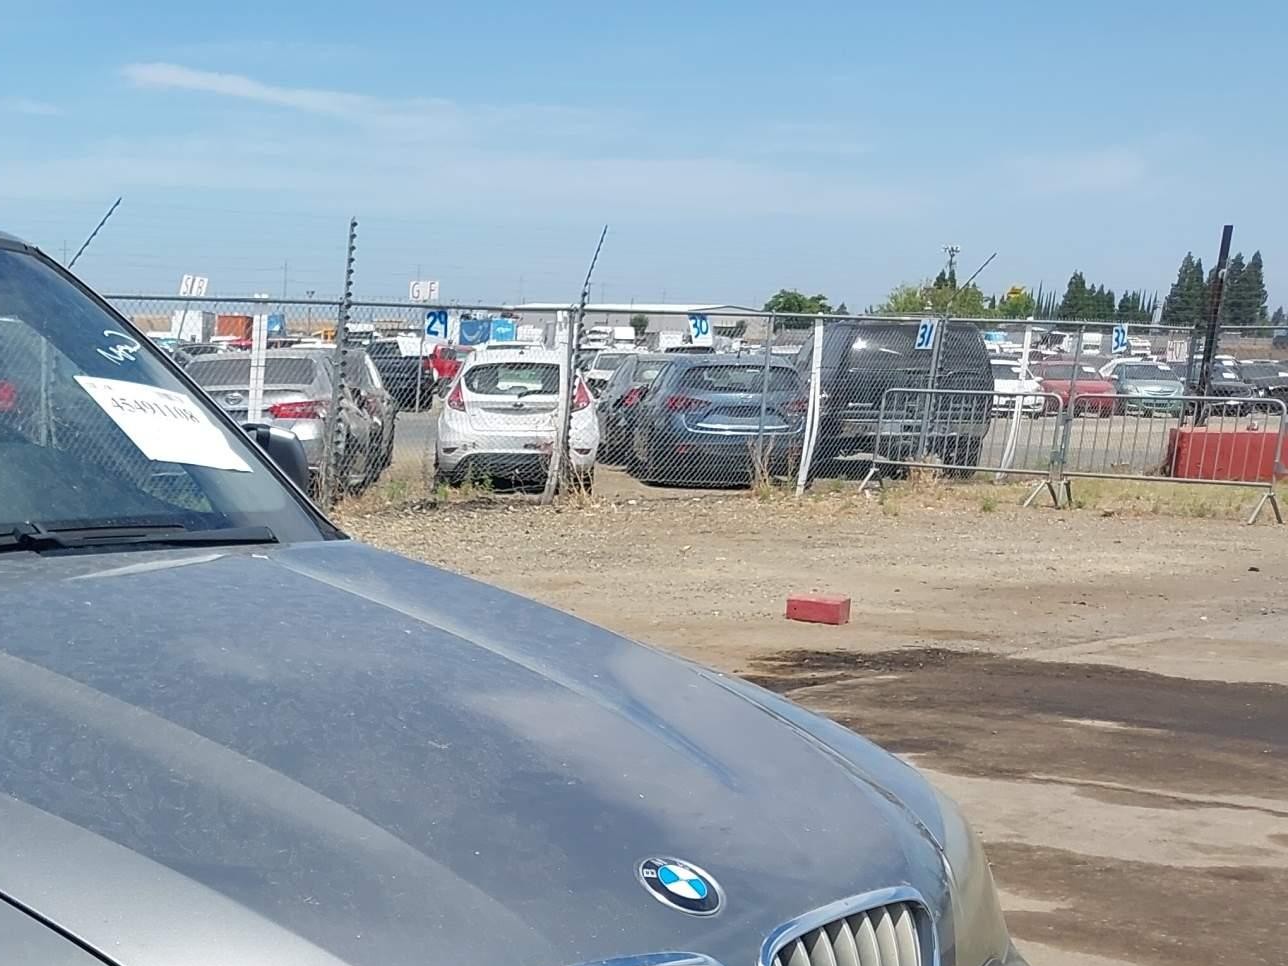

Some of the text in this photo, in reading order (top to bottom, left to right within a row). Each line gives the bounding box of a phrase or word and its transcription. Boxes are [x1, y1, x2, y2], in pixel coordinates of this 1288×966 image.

[411, 282, 420, 299] G
[426, 310, 448, 338] 29
[688, 315, 709, 338] 30
[917, 323, 934, 348] 31
[1113, 328, 1127, 351] 32
[110, 396, 200, 424] 45491108
